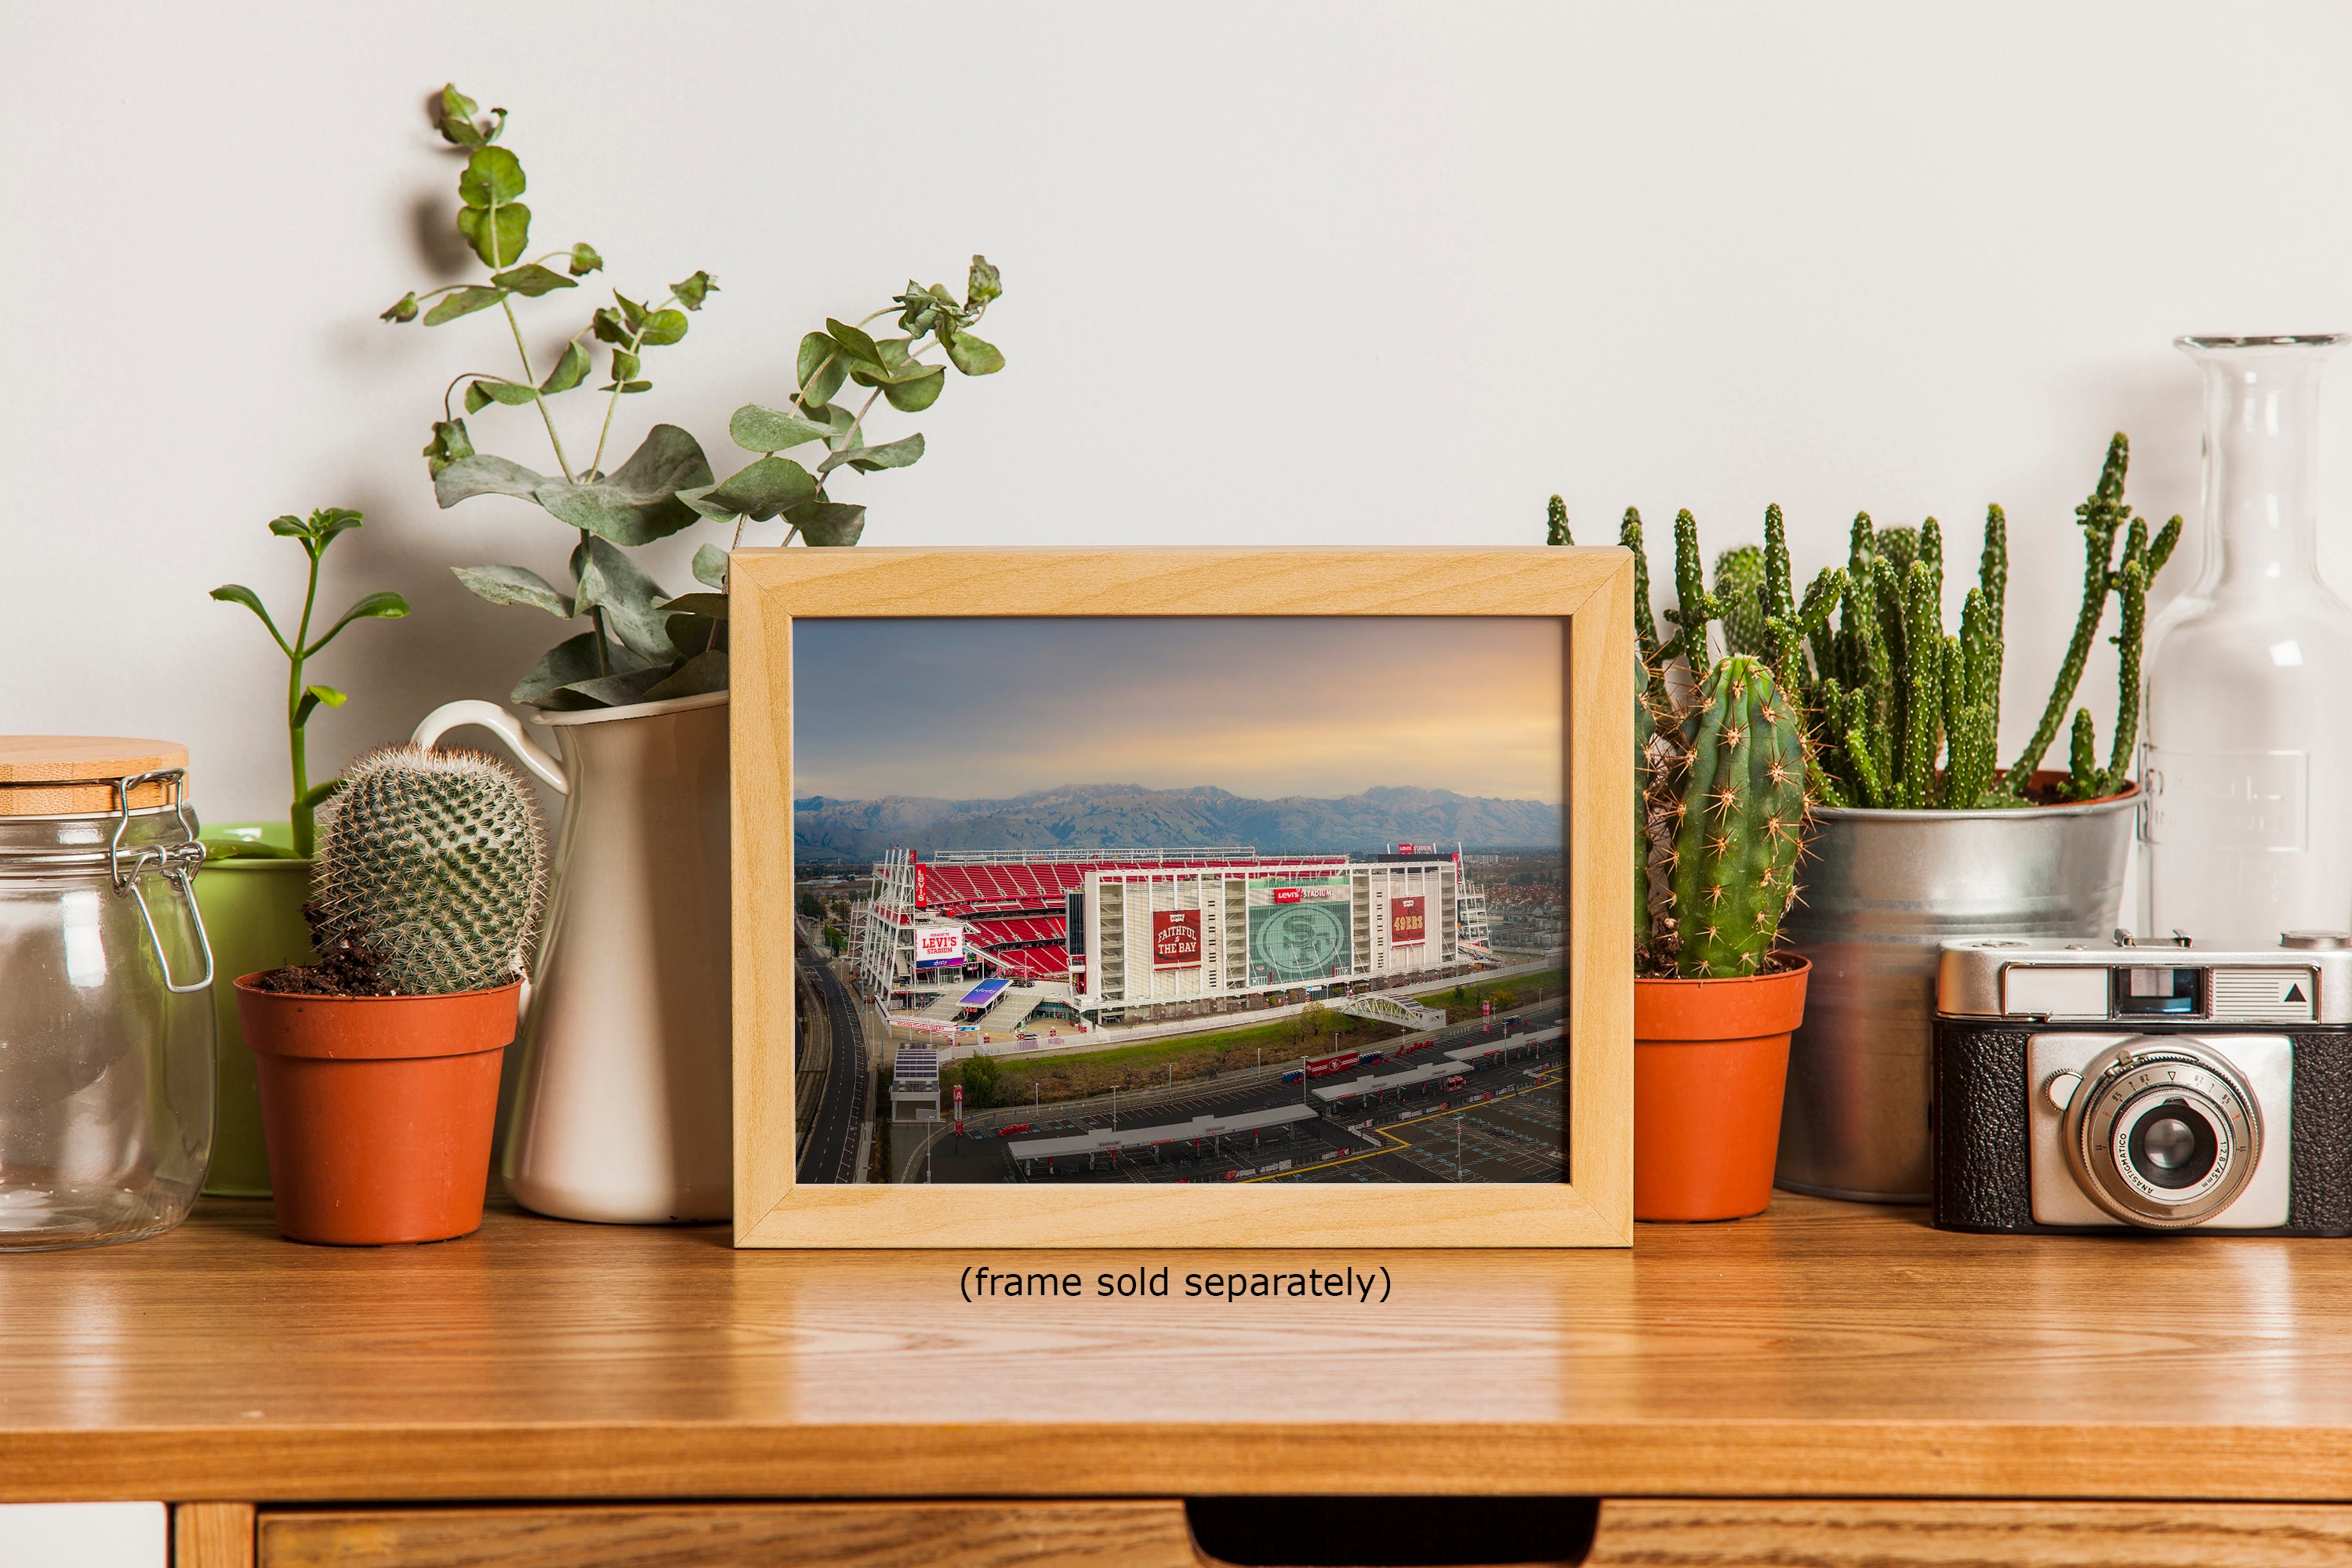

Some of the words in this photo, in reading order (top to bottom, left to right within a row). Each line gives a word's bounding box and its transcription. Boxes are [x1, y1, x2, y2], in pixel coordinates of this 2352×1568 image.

[1394, 915, 1424, 931] 49ERS
[922, 936, 957, 949] LEVI'S
[1158, 926, 1197, 943] FAITHFUL
[1158, 943, 1178, 954] THE
[1178, 942, 1197, 953] BAY
[2118, 1133, 2154, 1194] ANASTIGMATICO
